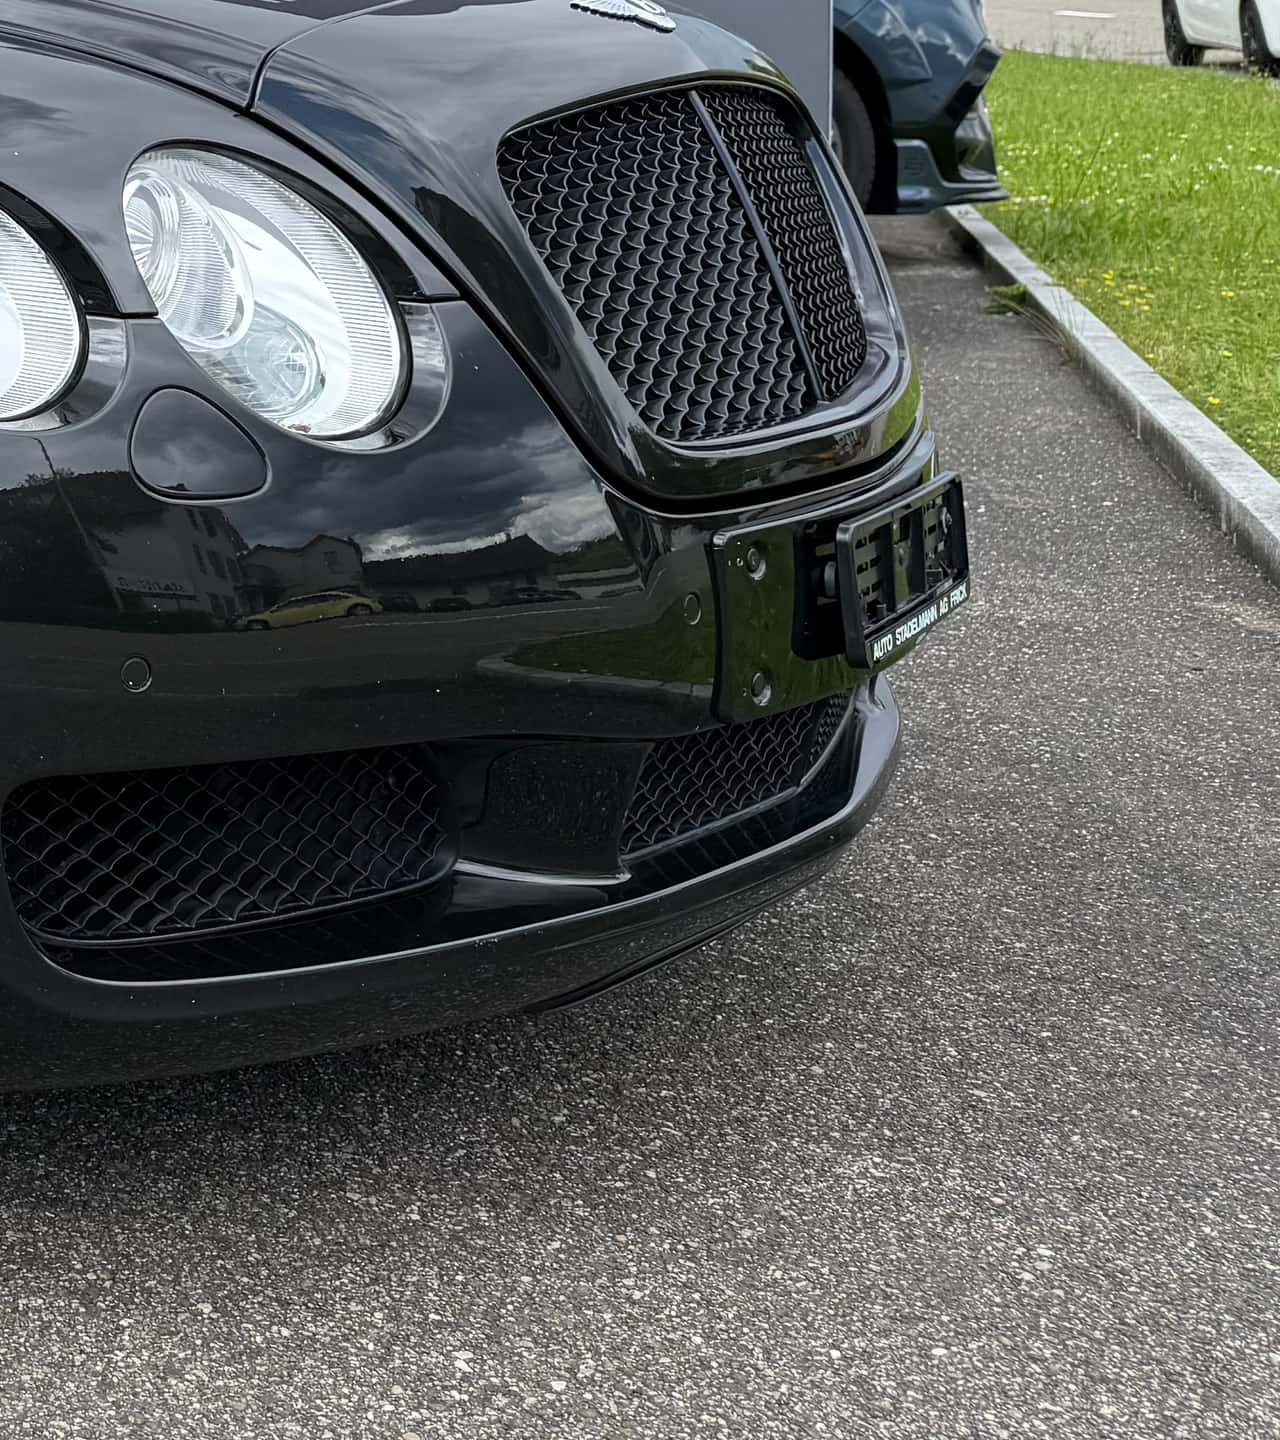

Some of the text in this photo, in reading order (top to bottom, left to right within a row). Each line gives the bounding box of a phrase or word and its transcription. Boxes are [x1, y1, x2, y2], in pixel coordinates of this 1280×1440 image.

[873, 583, 967, 661] AUTO STADELMANN AG FRICK
